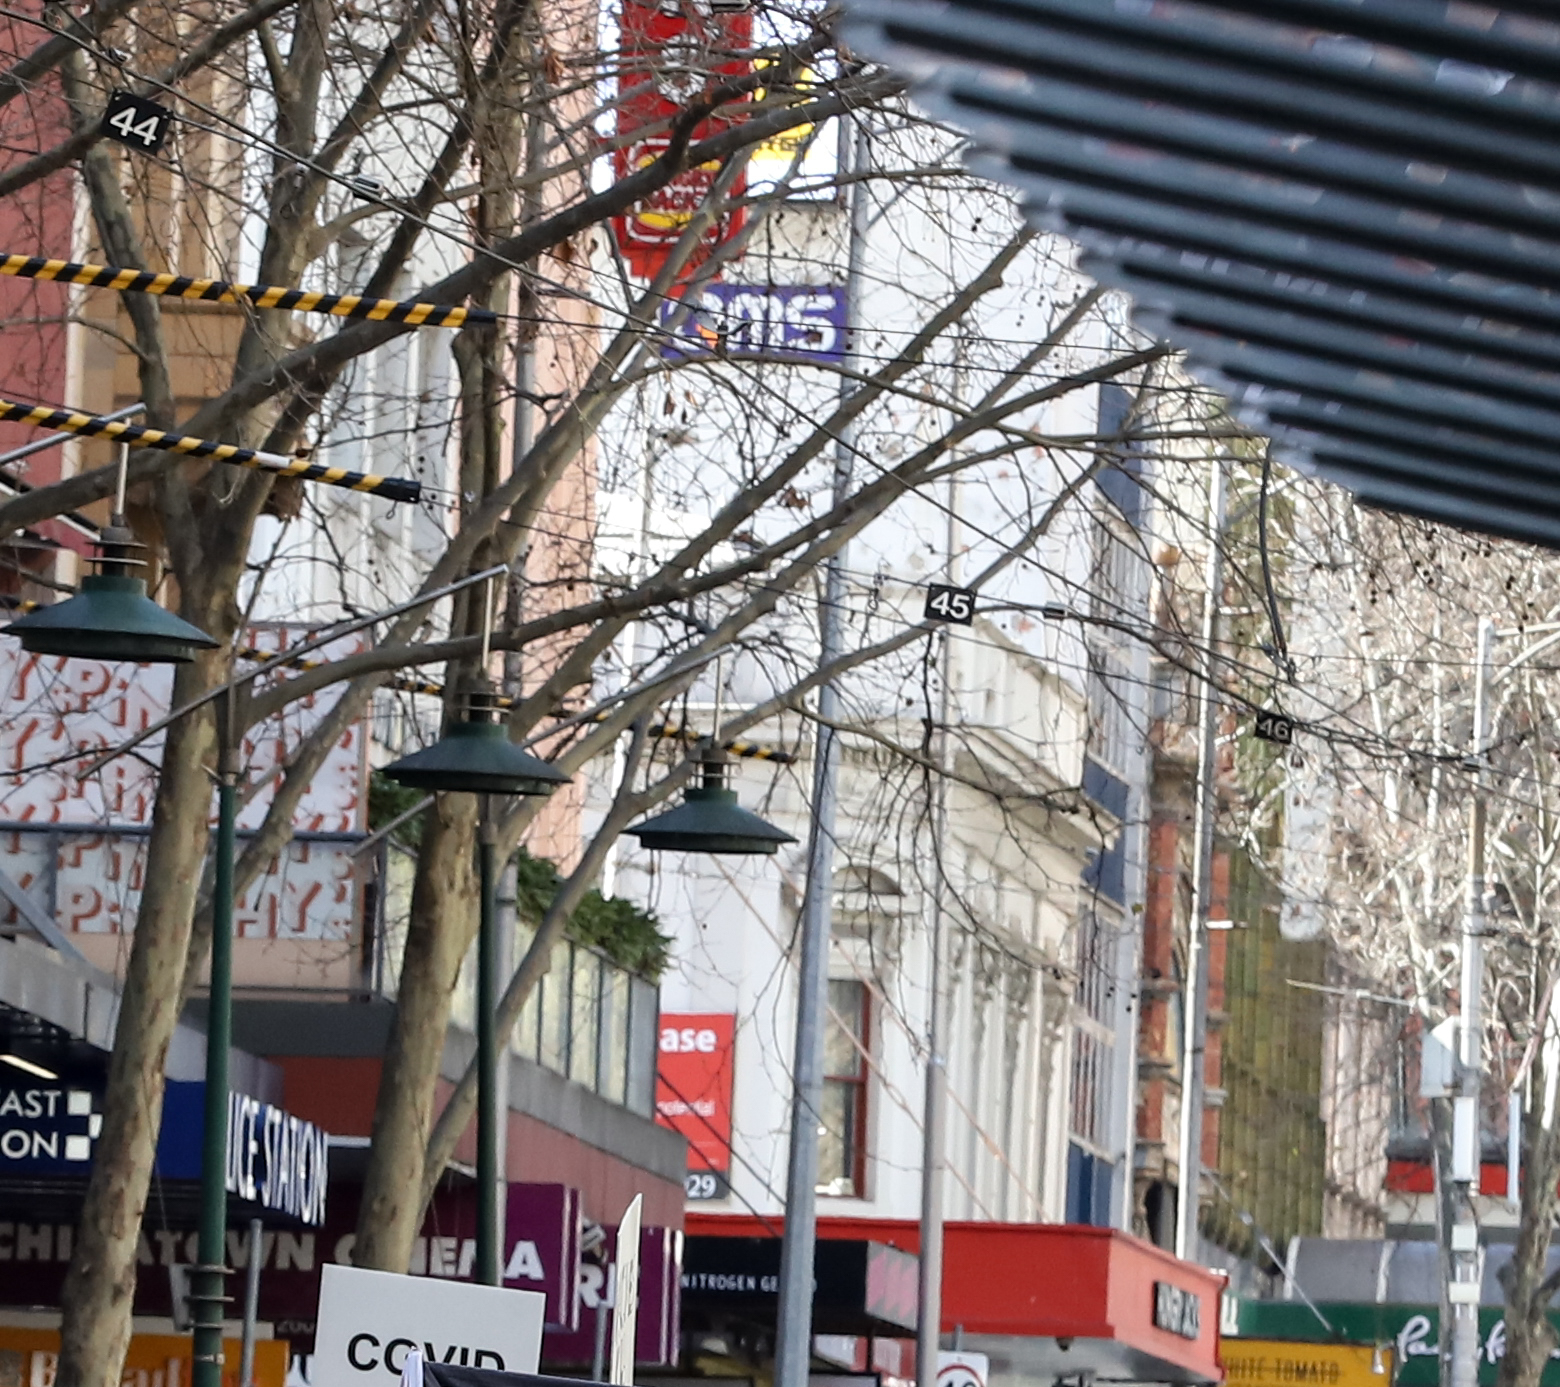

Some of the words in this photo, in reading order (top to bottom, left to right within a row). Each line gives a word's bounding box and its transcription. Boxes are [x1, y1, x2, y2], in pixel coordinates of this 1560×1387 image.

[110, 107, 159, 146] 44
[931, 591, 970, 619] 45
[659, 1027, 718, 1053] ase
[680, 1274, 755, 1292] NITROGEN
